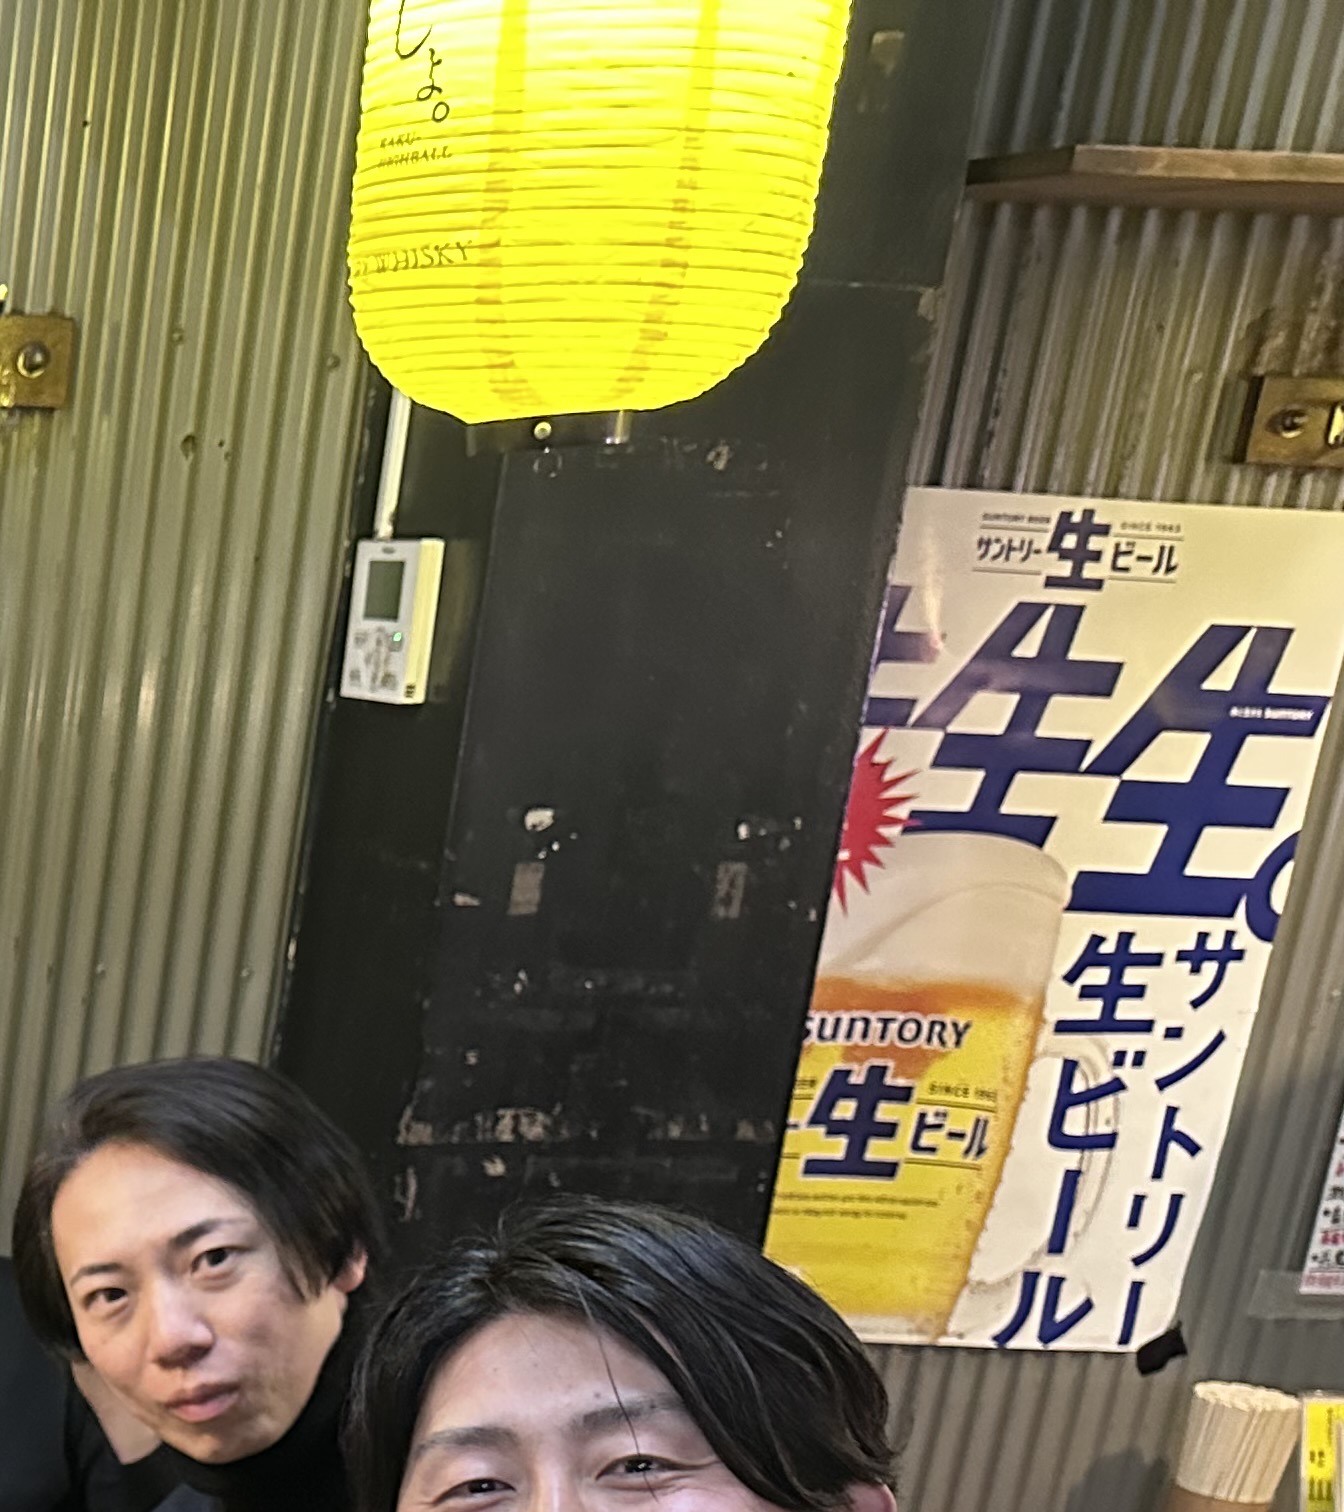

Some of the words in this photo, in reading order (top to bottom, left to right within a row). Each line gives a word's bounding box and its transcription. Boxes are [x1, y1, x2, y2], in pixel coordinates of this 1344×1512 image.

[374, 240, 473, 274] WHISKY
[993, 931, 1164, 1348] 生ビール
[1118, 930, 1246, 1346] サントリー
